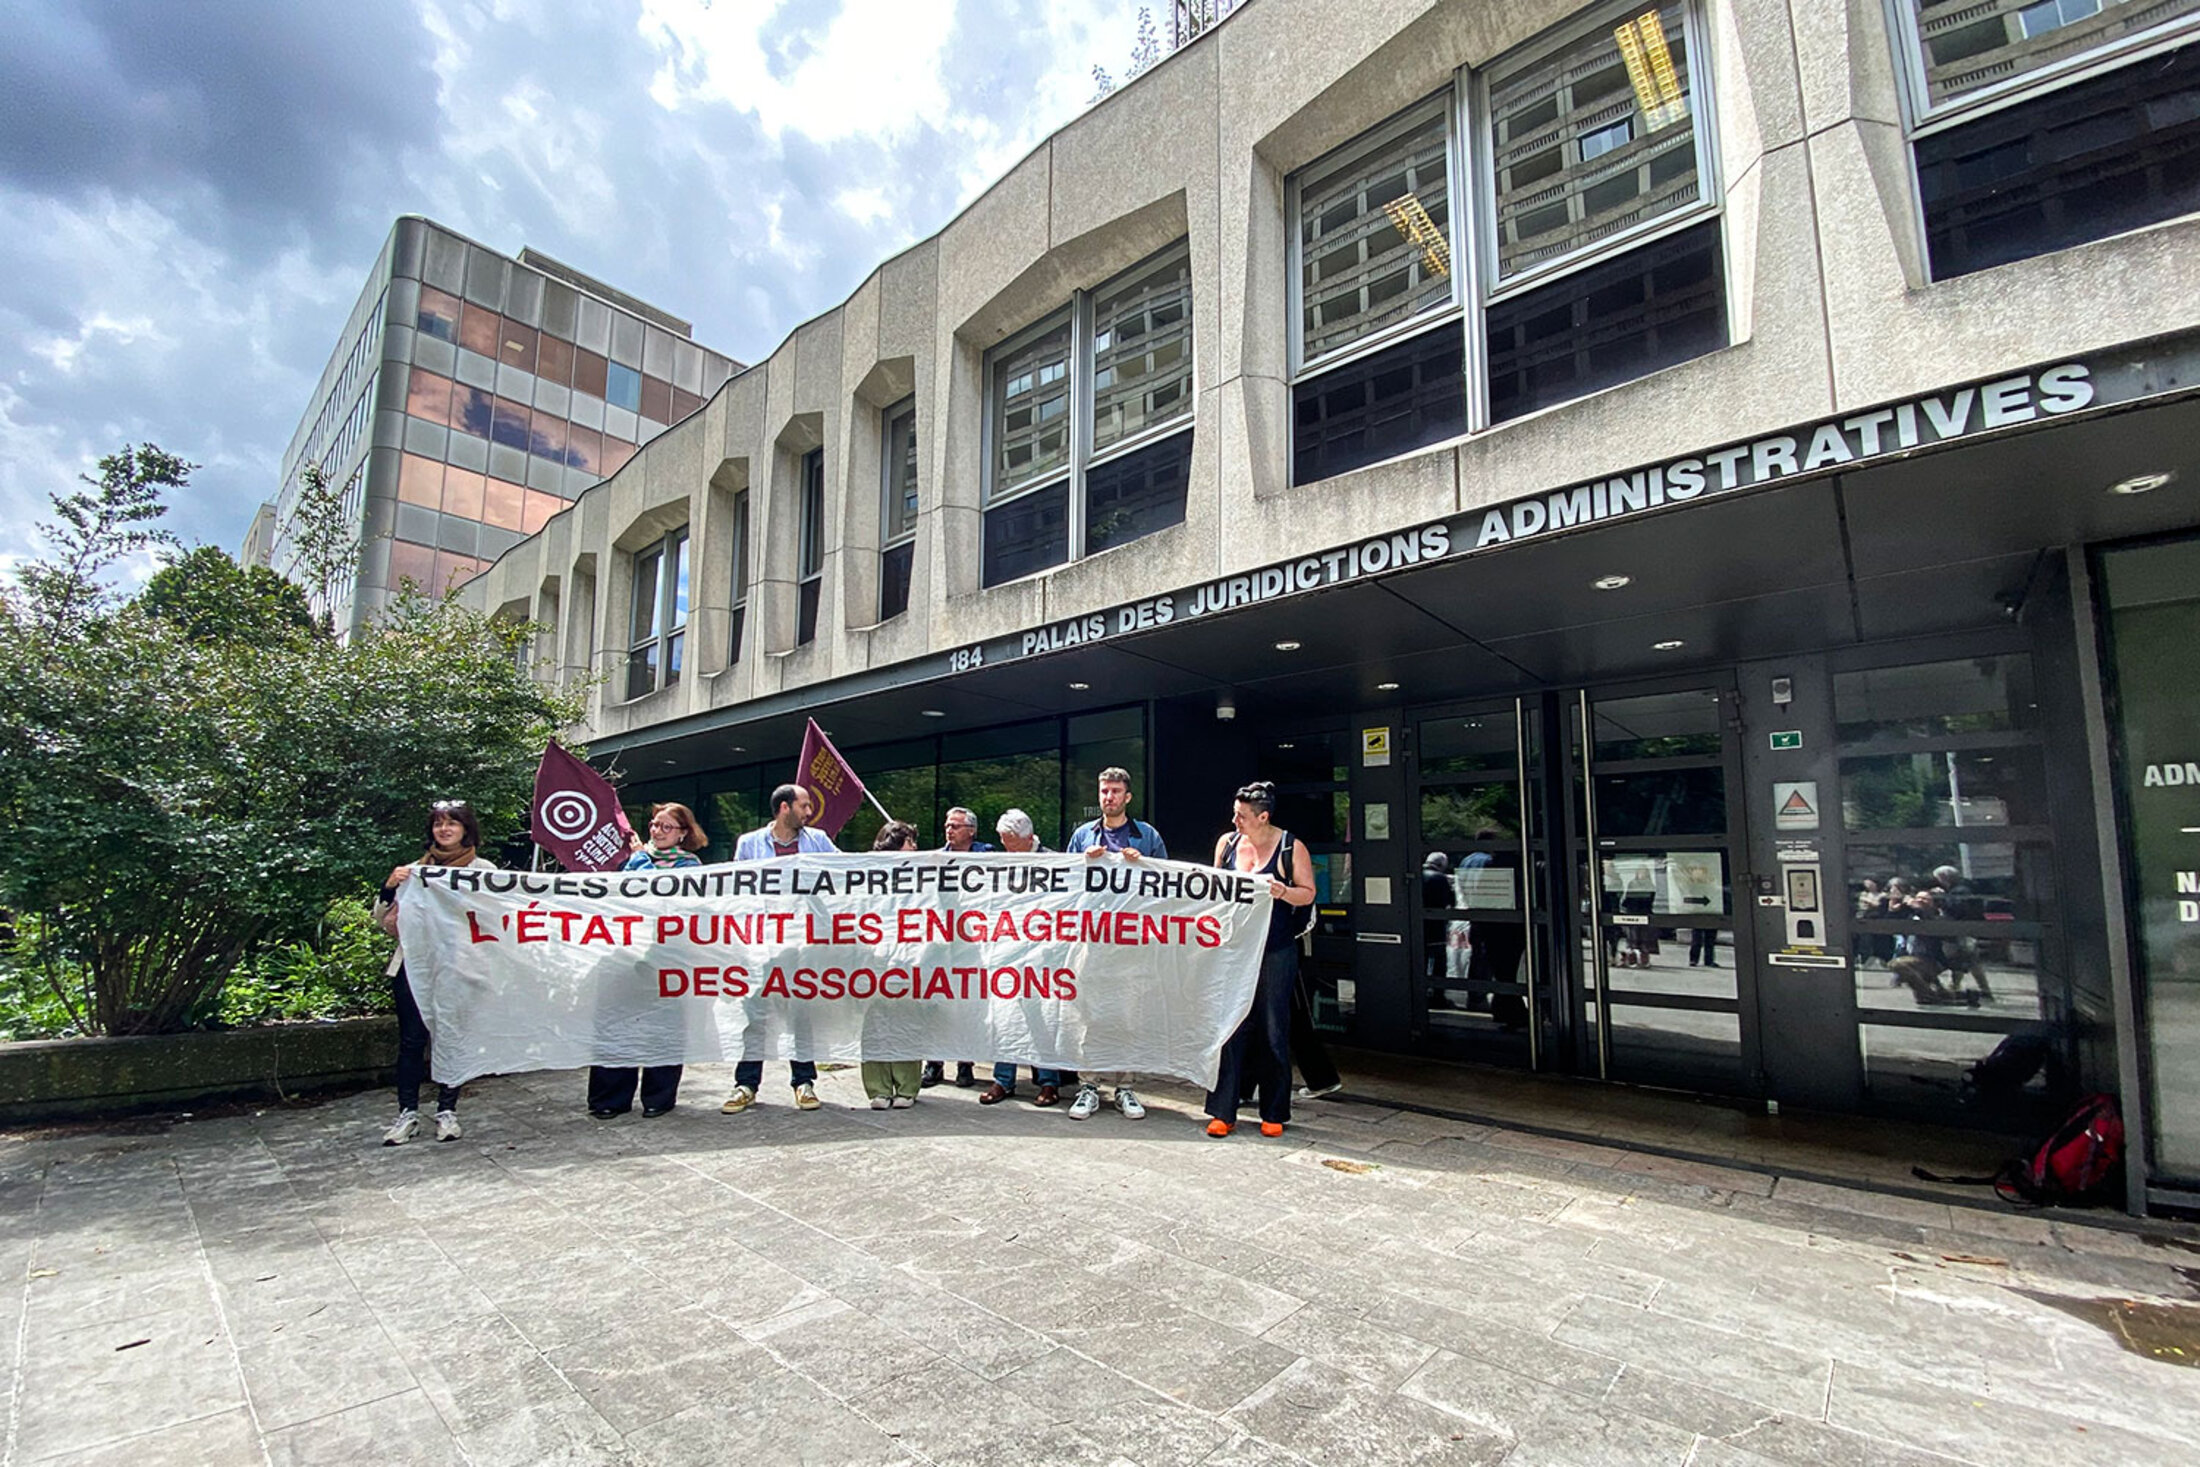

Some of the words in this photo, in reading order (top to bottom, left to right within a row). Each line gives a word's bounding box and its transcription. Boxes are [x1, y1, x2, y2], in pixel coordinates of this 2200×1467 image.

[949, 648, 983, 672] 184
[1022, 614, 1106, 655] PALAIS
[1118, 596, 1175, 635] DES
[1188, 523, 1451, 615] JURIDICTIONS
[1475, 363, 2095, 548] ADMINISTRATIVES
[620, 868, 782, 898] CONTRE
[791, 871, 836, 896] LA
[845, 859, 1070, 896] PRÉFÉCTURE
[1085, 866, 1133, 894] DU
[2176, 870, 2200, 893] N
[466, 901, 643, 946] L'ÉTAT
[657, 913, 794, 945] PUNIT
[805, 912, 883, 945] LES
[898, 908, 1222, 948] ENGAGEMENTS
[658, 966, 750, 999] DES
[762, 966, 1077, 1001] ASSOCIATIONS
